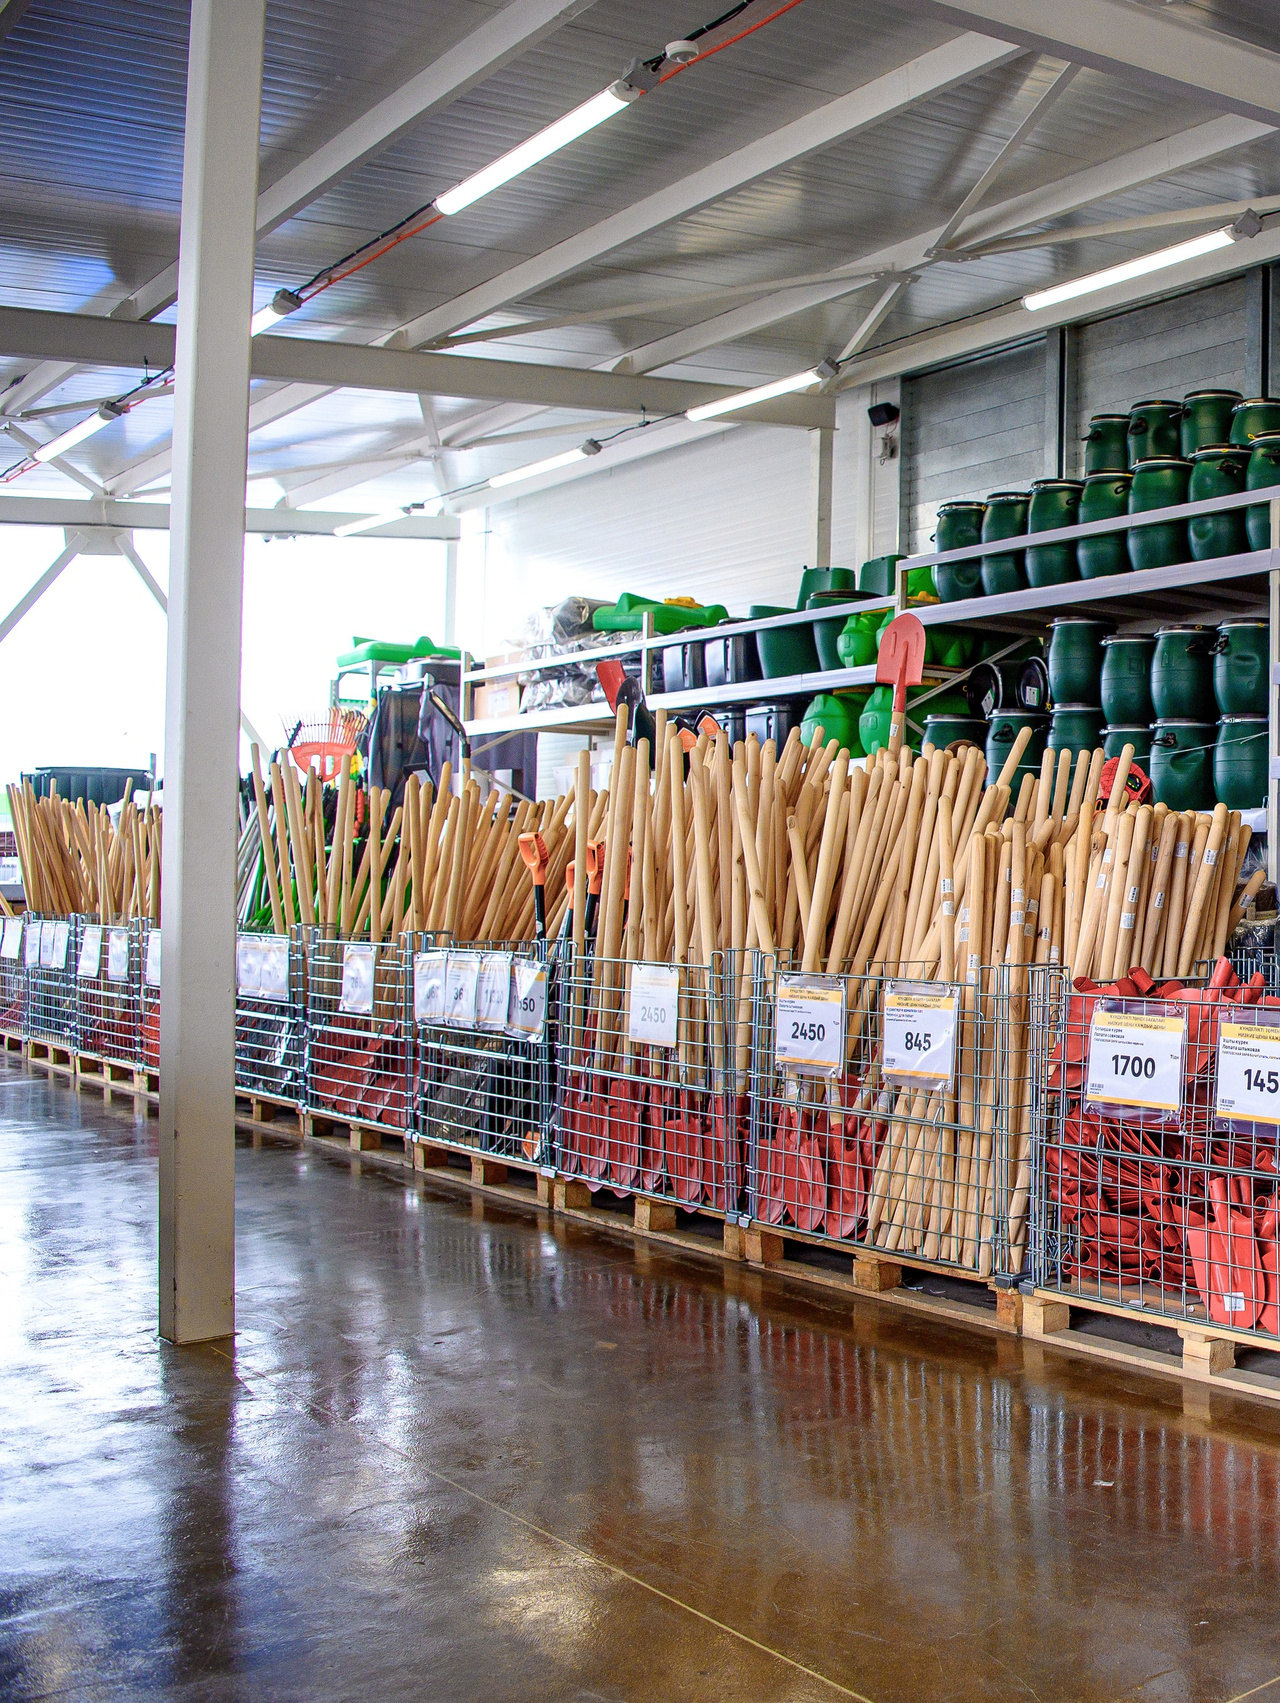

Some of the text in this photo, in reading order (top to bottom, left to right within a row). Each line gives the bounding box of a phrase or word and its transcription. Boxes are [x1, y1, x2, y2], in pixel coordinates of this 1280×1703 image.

[640, 1005, 667, 1024] 2450
[791, 1021, 826, 1042] 2450
[904, 1031, 932, 1052] 845
[1111, 1054, 1156, 1079] 1700
